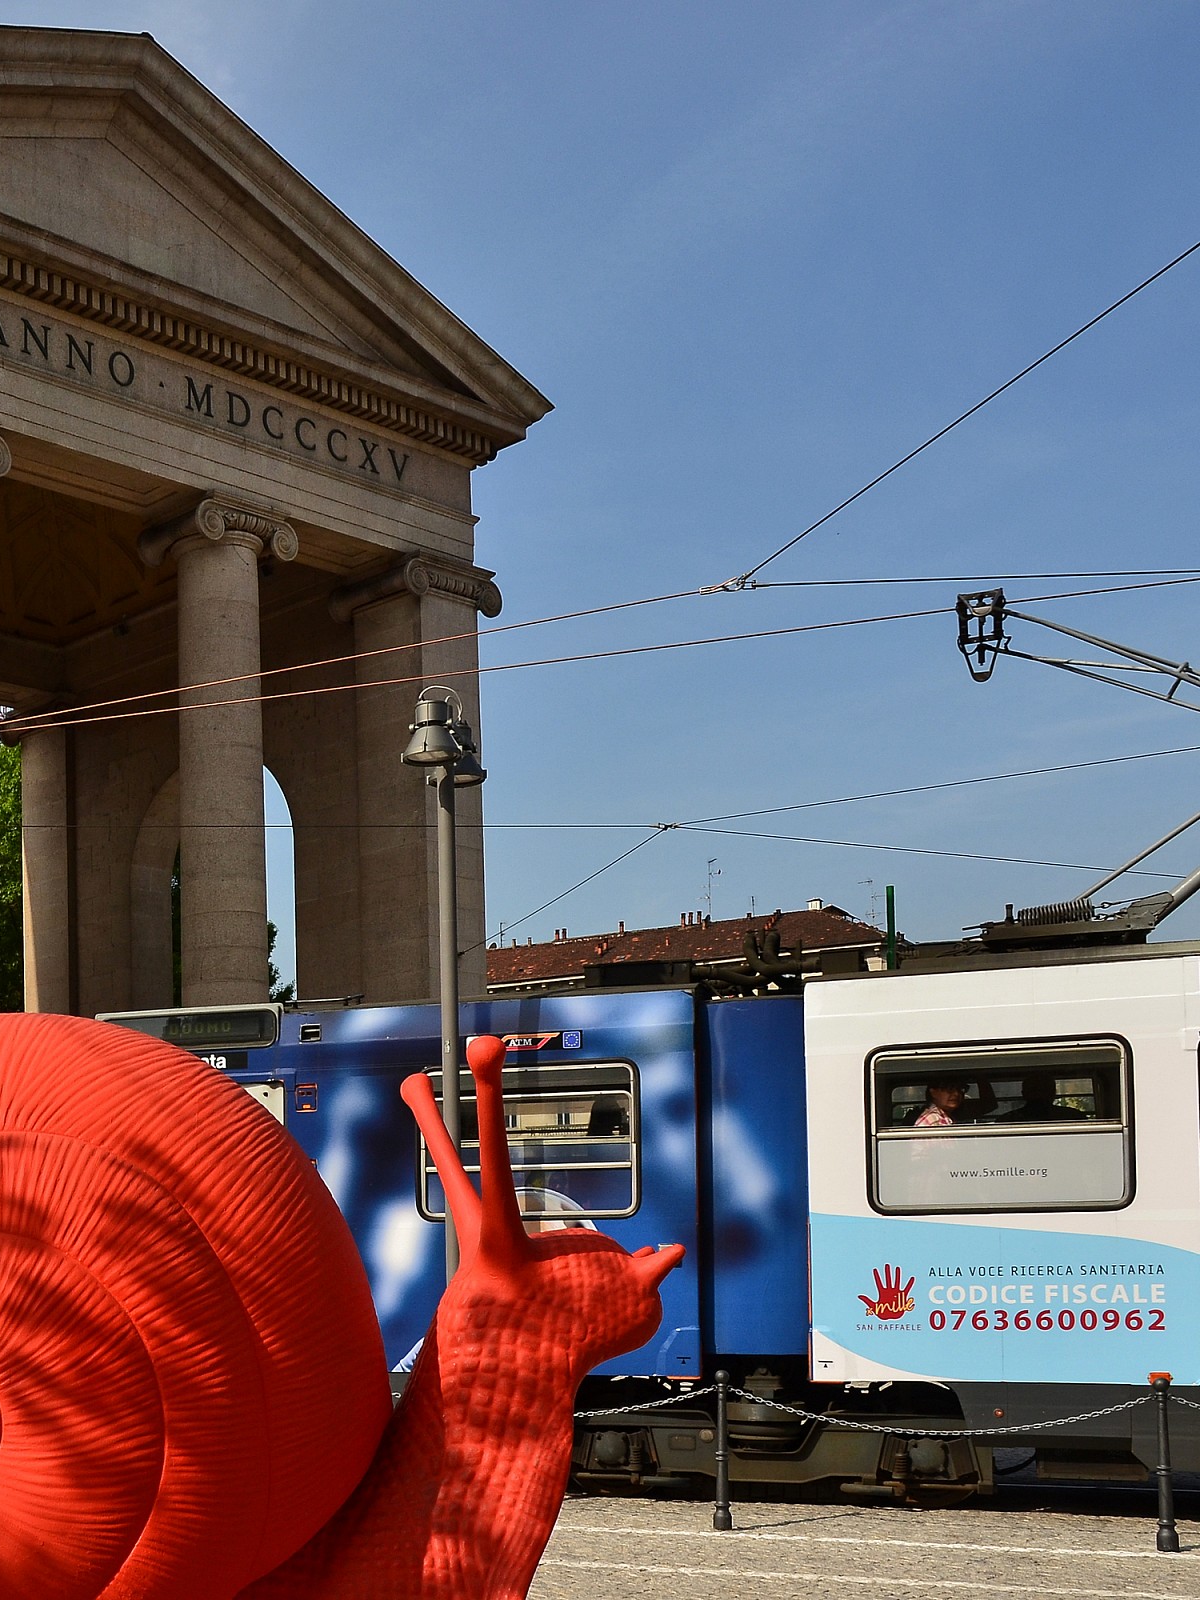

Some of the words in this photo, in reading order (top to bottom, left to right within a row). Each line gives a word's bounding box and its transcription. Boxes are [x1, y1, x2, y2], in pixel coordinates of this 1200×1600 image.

[184, 375, 410, 482] MDCCCXV
[508, 1038, 533, 1047] ATM
[949, 1166, 1048, 1178] www.5xmille.org
[928, 1266, 963, 1277] ALLA
[968, 1266, 1004, 1277] VOCE
[1011, 1265, 1074, 1276] RICERCA
[1080, 1264, 1165, 1275] SANITARIA
[928, 1284, 1034, 1305] CODICE
[1044, 1283, 1166, 1304] FISCALE
[875, 1291, 915, 1315] mille
[878, 1323, 922, 1331] RAFFAELE
[929, 1309, 1166, 1331] 07636600962
